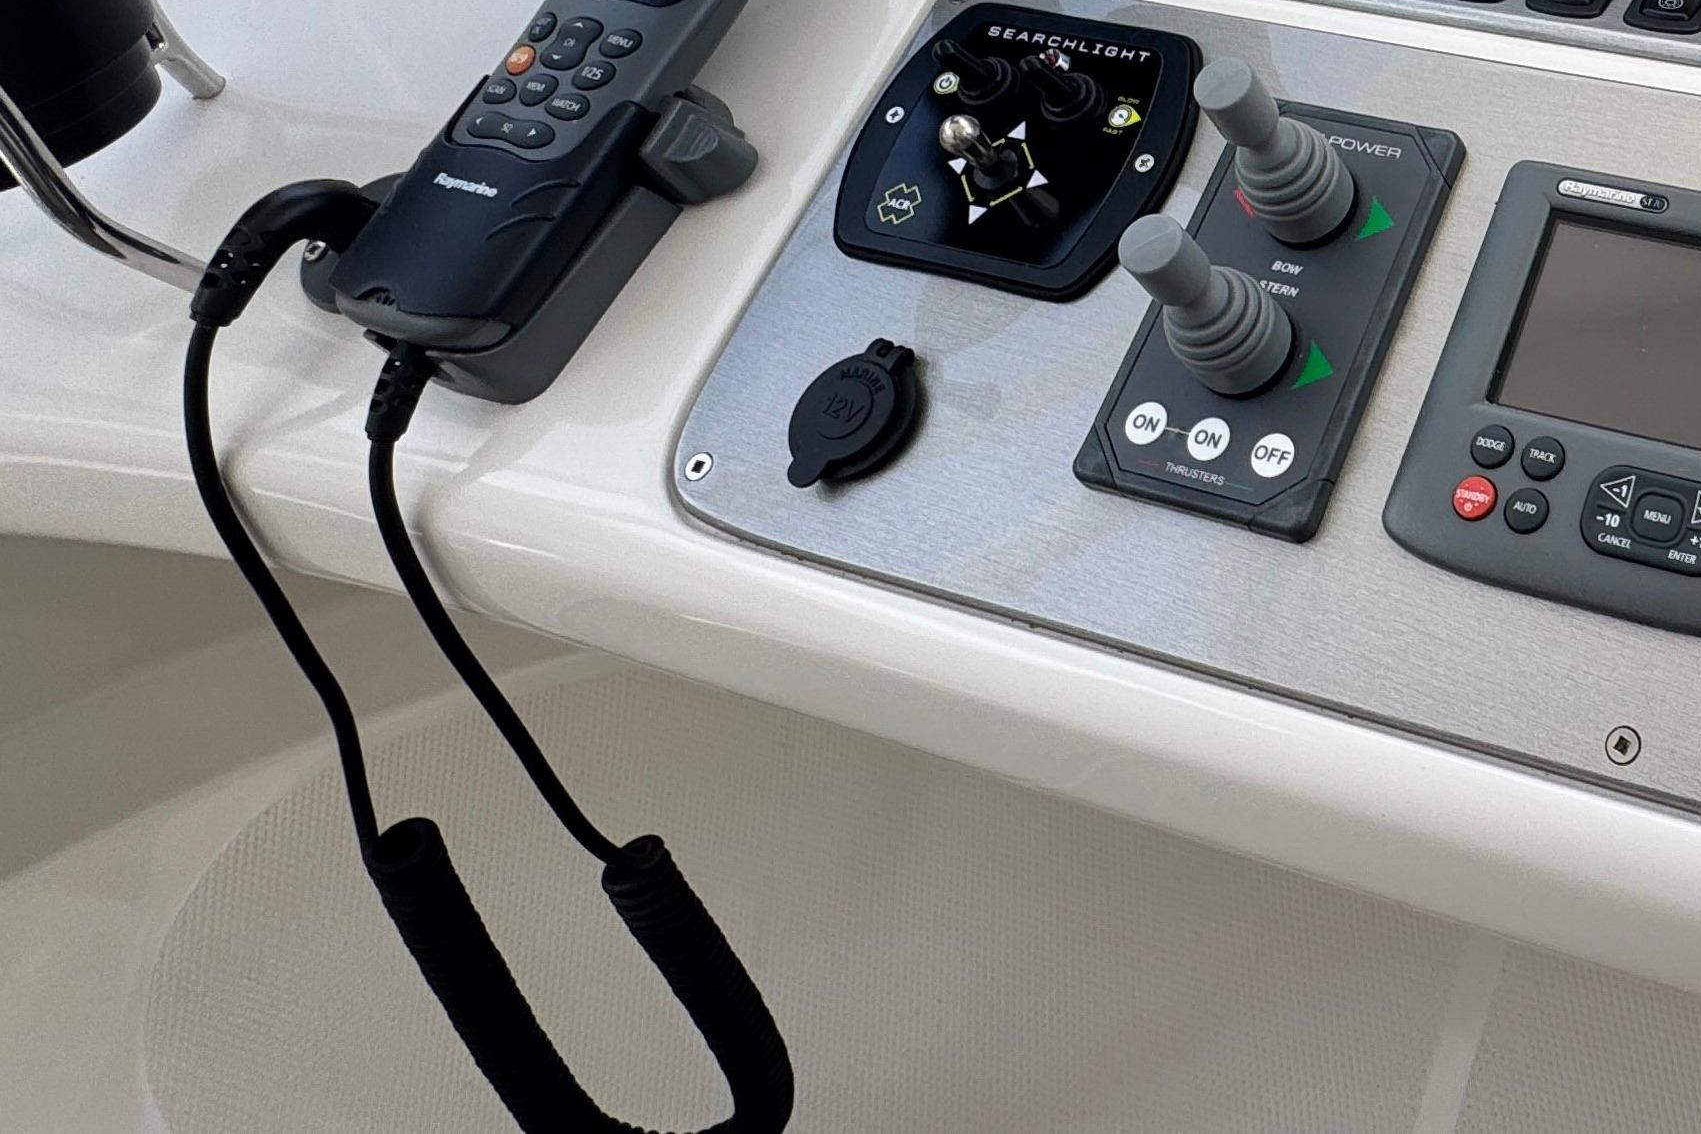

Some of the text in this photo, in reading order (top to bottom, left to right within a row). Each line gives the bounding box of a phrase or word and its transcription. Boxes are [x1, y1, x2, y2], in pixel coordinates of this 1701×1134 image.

[607, 34, 633, 49] MENU
[987, 25, 1151, 62] SEARCHLIGHT
[551, 97, 581, 112] WATCH
[433, 172, 498, 199] Raymarine
[1271, 260, 1304, 275] BOW
[1259, 280, 1300, 297] STERN
[822, 393, 864, 422] 12V
[1132, 413, 1291, 465] ON ON OFF
[1476, 436, 1506, 452] DODGE
[1529, 448, 1556, 463] TRACK
[1165, 461, 1226, 486] THRUSTERS
[1455, 488, 1489, 504] STANDBY
[1612, 485, 1628, 497] -1
[1512, 500, 1537, 514] AUTO
[1596, 513, 1621, 528] -10
[1643, 509, 1672, 525] MENU
[1597, 532, 1632, 549] CANCEL
[1667, 549, 1698, 565] ENTER
